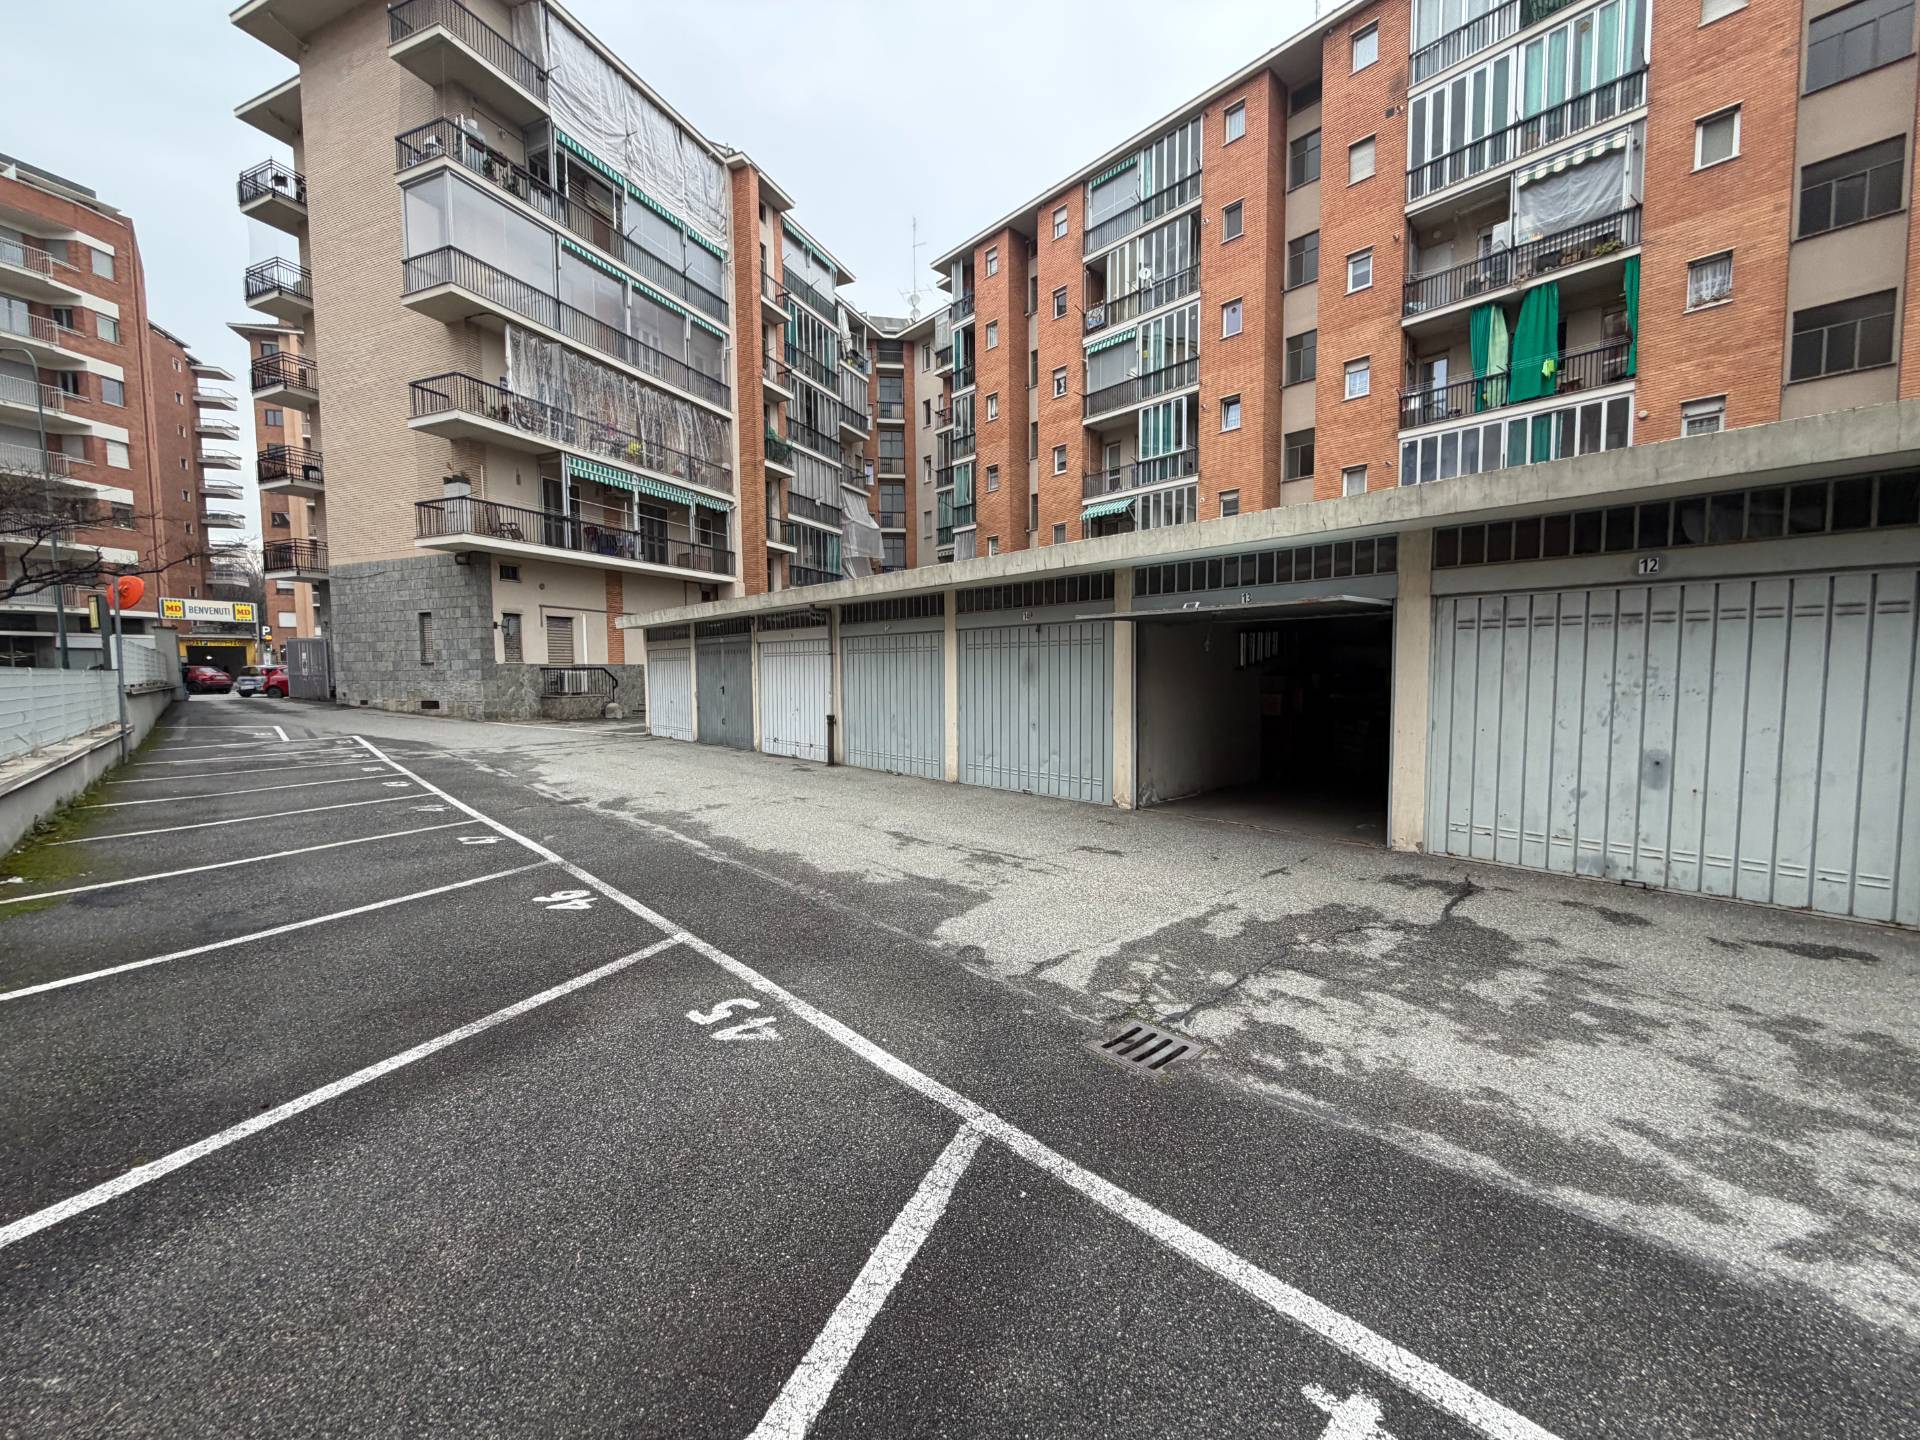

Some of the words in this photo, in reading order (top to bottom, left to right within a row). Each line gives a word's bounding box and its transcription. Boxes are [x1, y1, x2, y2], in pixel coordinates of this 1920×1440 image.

[1640, 558, 1658, 573] 12
[165, 604, 182, 613] MD
[188, 606, 231, 616] BENVENUTI
[262, 625, 271, 635] P
